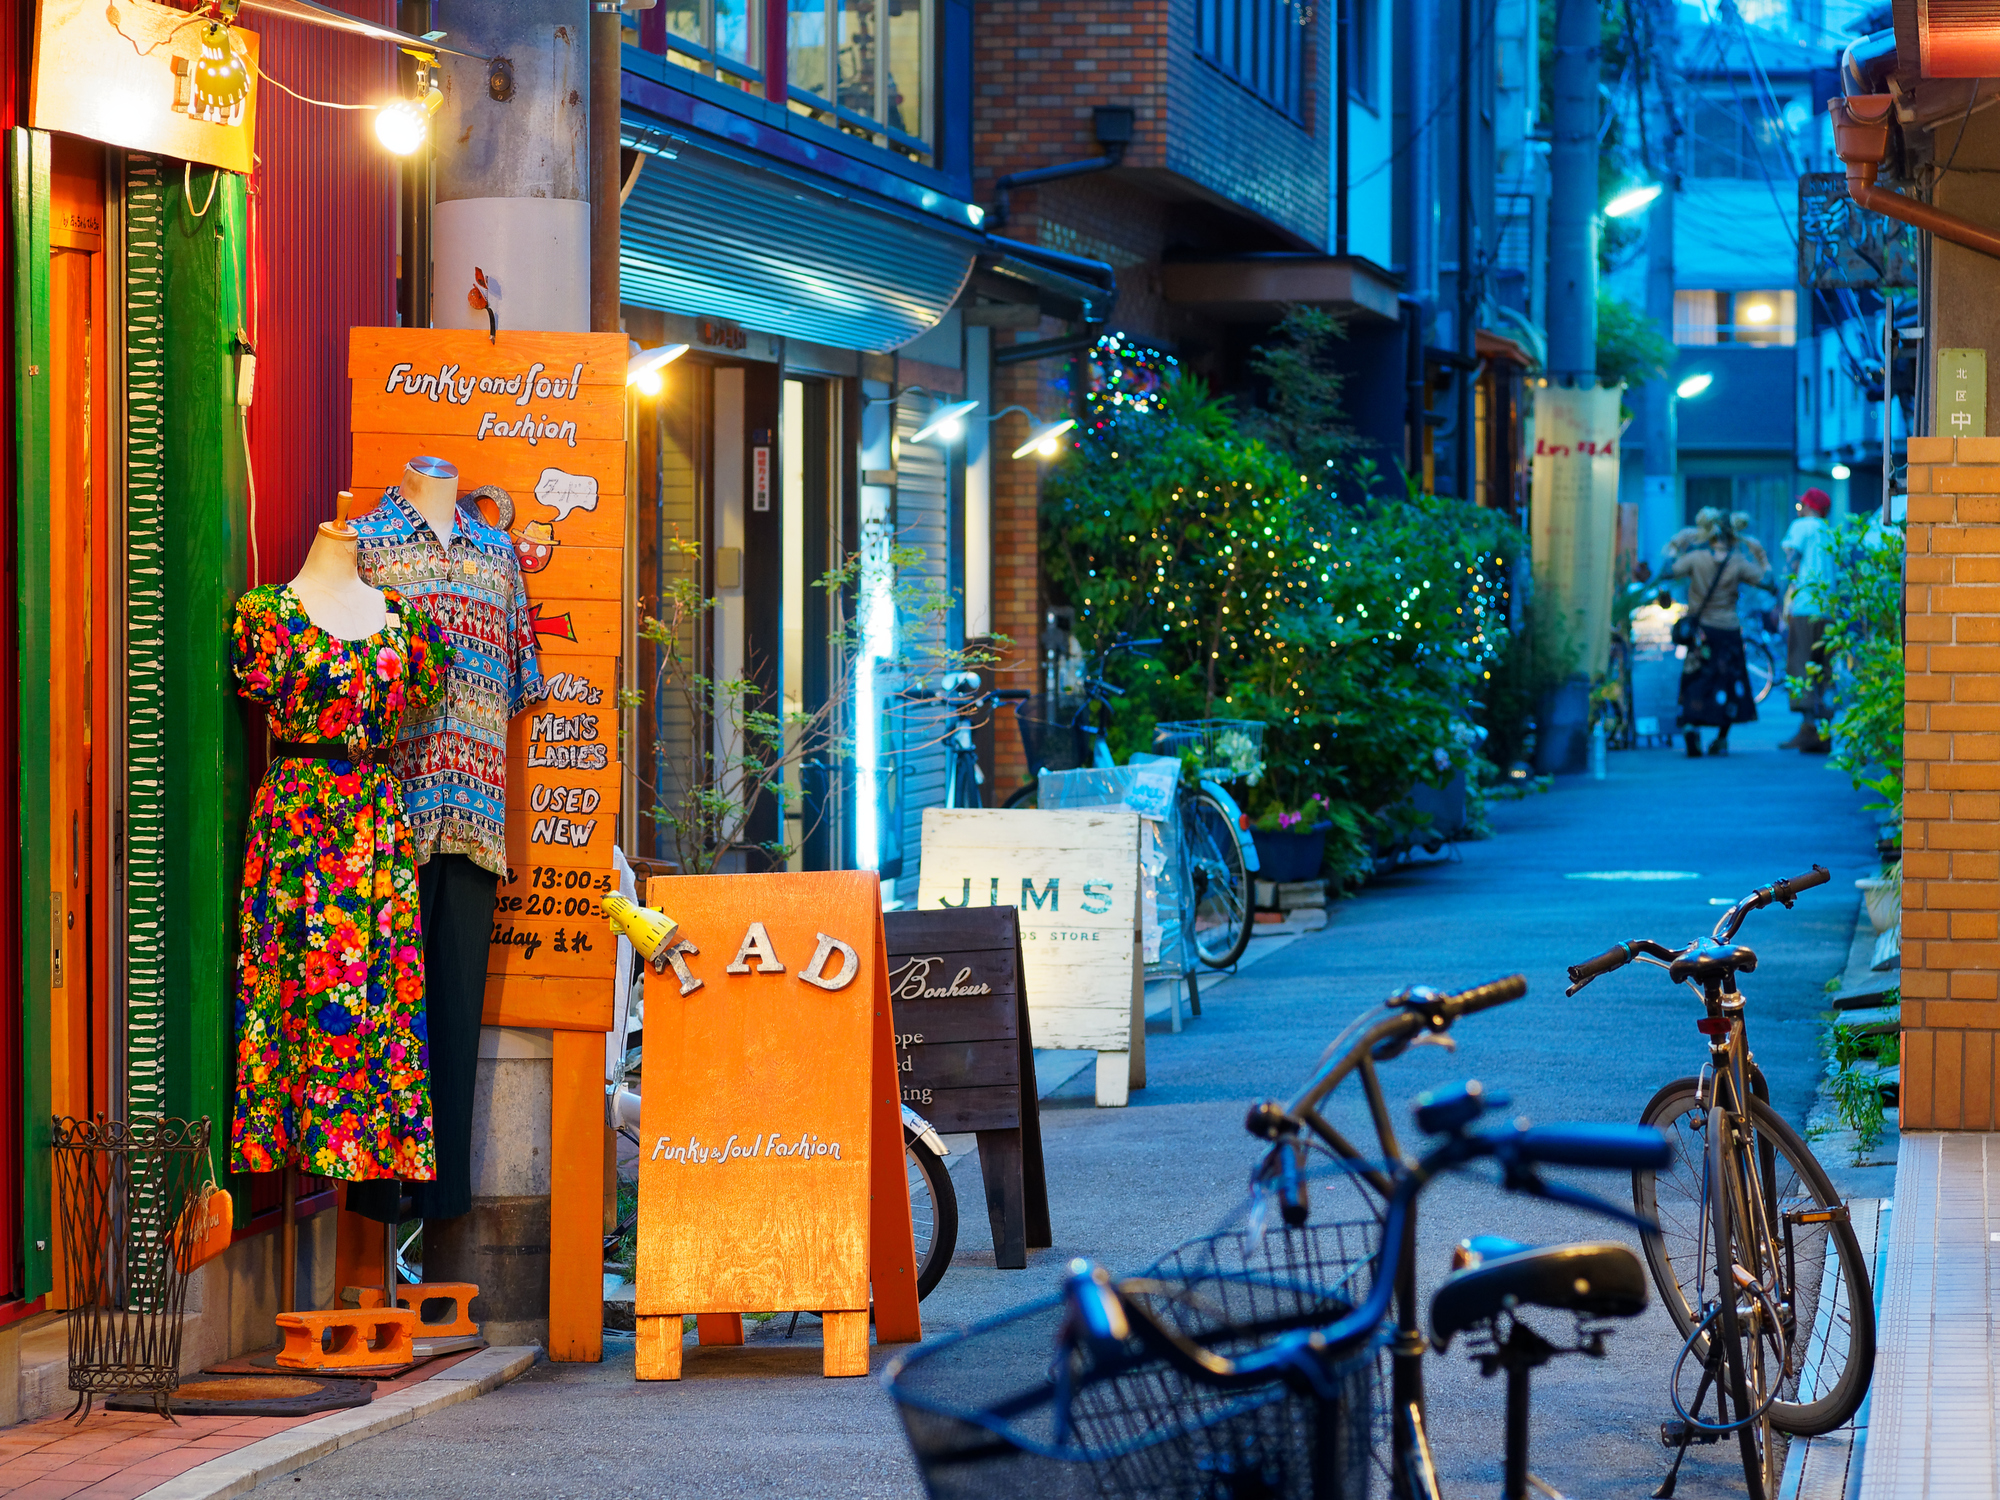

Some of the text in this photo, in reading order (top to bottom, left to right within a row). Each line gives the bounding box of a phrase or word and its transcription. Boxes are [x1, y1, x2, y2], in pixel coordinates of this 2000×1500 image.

[479, 374, 522, 395] and
[515, 362, 583, 406] Soul
[1951, 367, 1972, 438] 北区中
[477, 412, 577, 447] Fashion
[530, 712, 599, 742] MEN'S
[530, 783, 601, 815] USED
[531, 816, 597, 848] NEW
[939, 878, 1114, 915] JIMS
[554, 928, 592, 953] まれ
[1050, 931, 1100, 941] STORE
[889, 956, 992, 1000] Bonheur
[765, 1132, 842, 1161] Fashion
